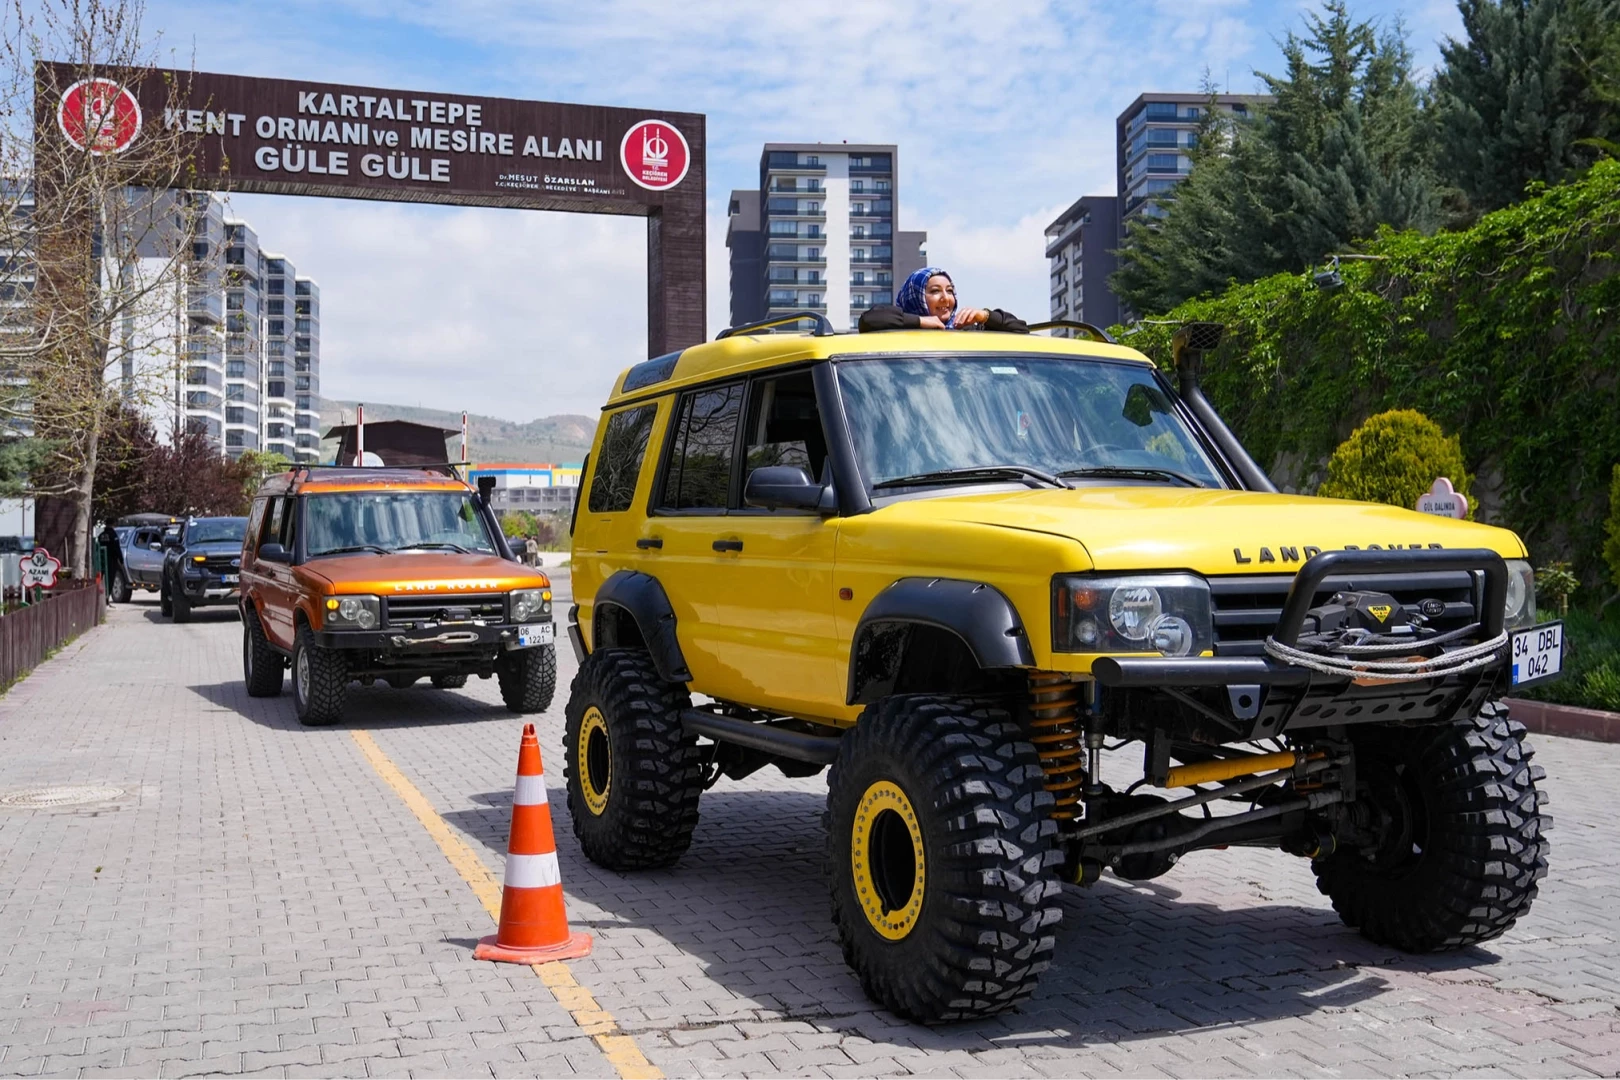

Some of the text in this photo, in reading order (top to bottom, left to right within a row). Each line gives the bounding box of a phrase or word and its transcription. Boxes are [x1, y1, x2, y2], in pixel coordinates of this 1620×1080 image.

[298, 91, 482, 126] KARTALTEPE
[164, 108, 603, 162] KENT ORMANI ve MESİRE ALANI
[254, 143, 450, 183] GÜLE GÜLE
[544, 174, 595, 186] ÖZARSLAN
[1434, 502, 1455, 511] DALINDA
[1234, 546, 1322, 564] LAND
[448, 581, 497, 589] ROVER
[520, 625, 550, 635] 06 AC
[529, 636, 545, 644] 1221
[1514, 629, 1559, 657] 34 DBL
[1528, 653, 1548, 677] 042
